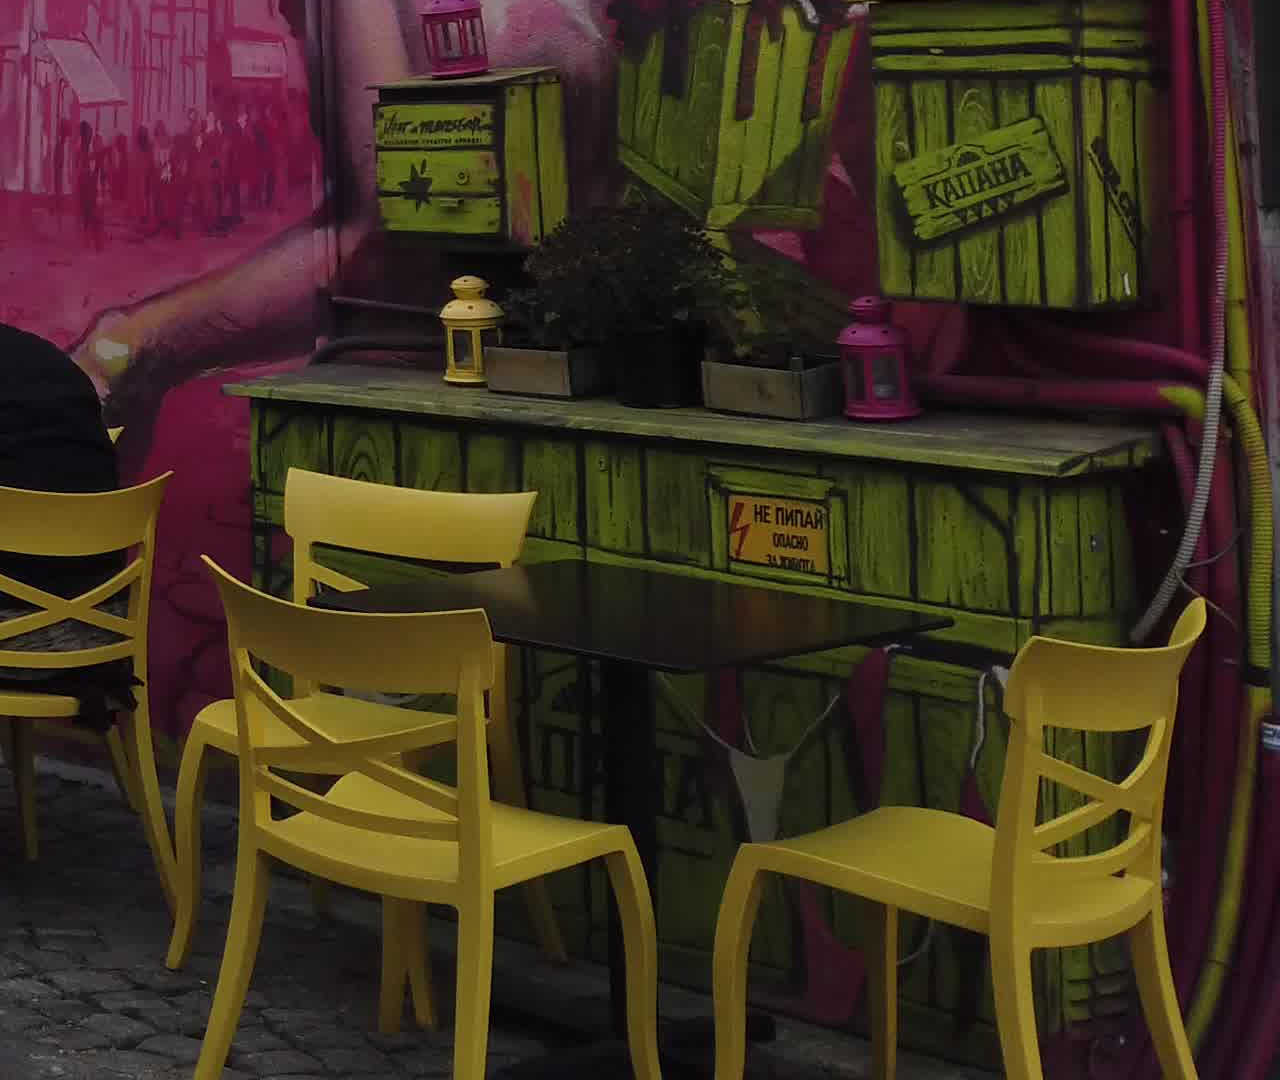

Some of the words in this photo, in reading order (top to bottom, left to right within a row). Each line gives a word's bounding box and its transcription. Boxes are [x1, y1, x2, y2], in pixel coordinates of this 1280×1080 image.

[924, 152, 1032, 208] КАПАНА
[754, 504, 771, 524] НЕ
[775, 506, 823, 530] ПИПАЙ
[773, 533, 809, 551] ОПАСНО
